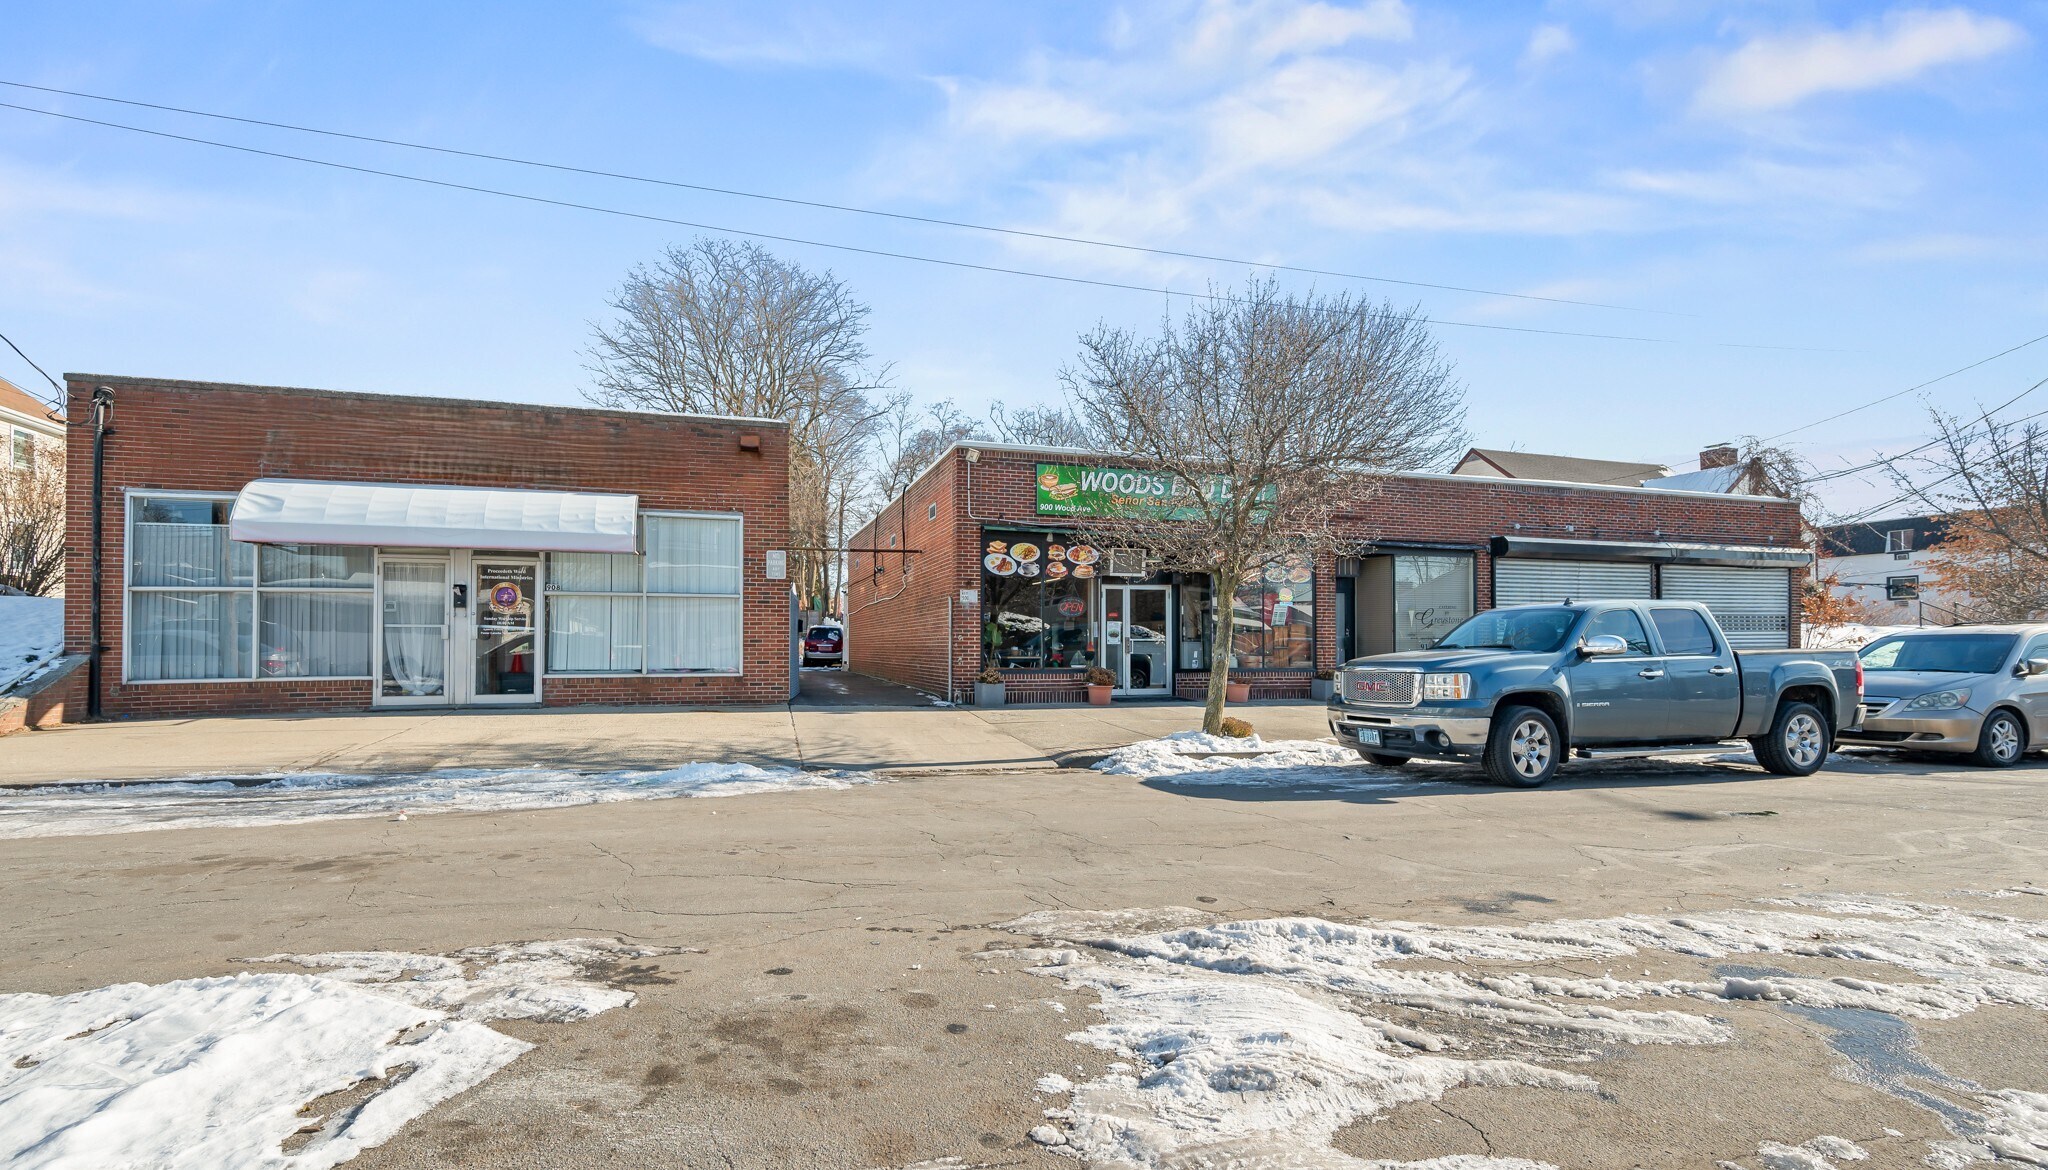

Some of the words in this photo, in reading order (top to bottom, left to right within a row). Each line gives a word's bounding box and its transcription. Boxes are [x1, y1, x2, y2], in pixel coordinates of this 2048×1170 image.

[1081, 470, 1165, 495] WOODS
[1111, 493, 1143, 506] Señor
[1040, 503, 1053, 511] 900
[1055, 504, 1077, 512] Wood
[1060, 601, 1084, 612] OPEN
[1356, 680, 1389, 692] GMC
